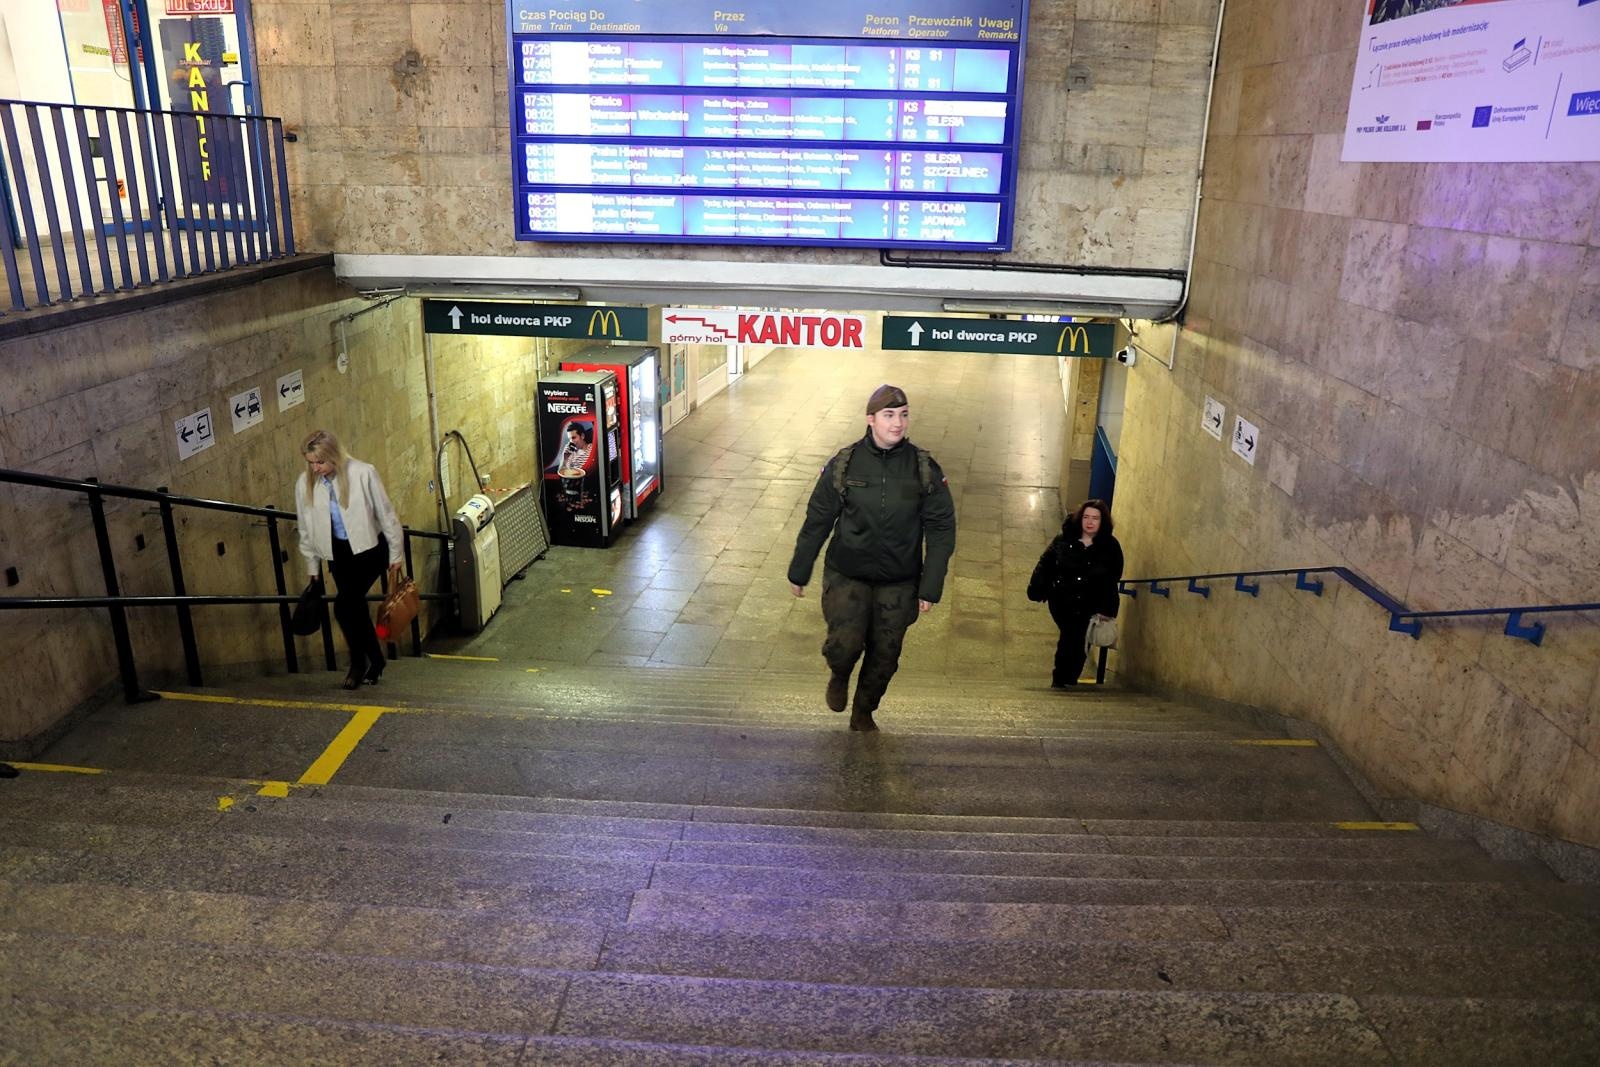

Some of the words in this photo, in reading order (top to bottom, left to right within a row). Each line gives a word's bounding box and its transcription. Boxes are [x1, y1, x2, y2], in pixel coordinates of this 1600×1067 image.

[519, 10, 546, 20] Czas
[549, 10, 587, 22] Pociąg
[589, 10, 605, 20] Do
[714, 11, 745, 21] Przez
[865, 14, 899, 25] Peron
[908, 15, 973, 27] Przewoźnik
[979, 17, 1014, 31] Uwagi
[521, 23, 542, 31] Time
[551, 23, 572, 31] Train
[590, 23, 641, 32] Destination
[715, 24, 729, 32] Via
[862, 27, 900, 36] Platform
[908, 28, 949, 38] Operator
[978, 30, 1018, 40] Remarks
[471, 313, 491, 324] hol
[494, 314, 541, 326] dworca
[544, 316, 572, 328] PKP
[669, 334, 702, 344] górny
[705, 334, 723, 343] hol
[737, 314, 863, 348] KANTOR
[932, 329, 953, 340] hol
[957, 330, 1005, 342] dworca
[1008, 332, 1038, 344] PKP
